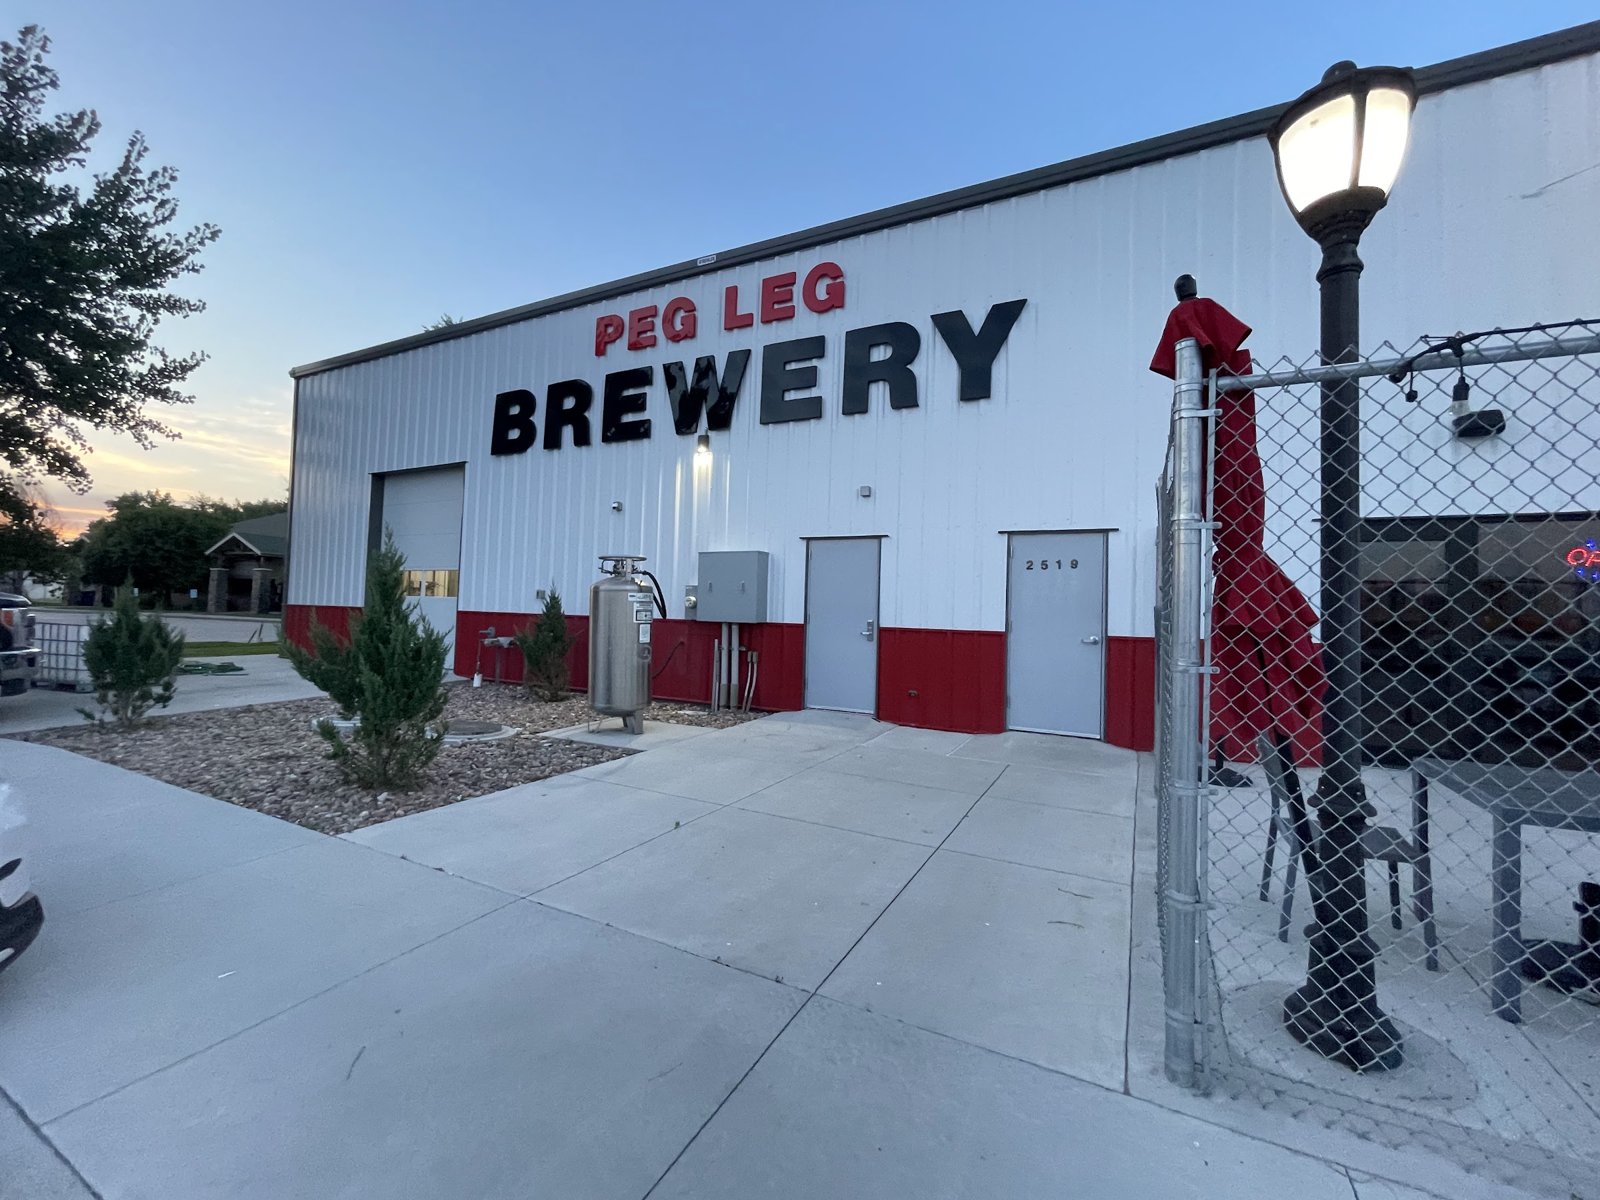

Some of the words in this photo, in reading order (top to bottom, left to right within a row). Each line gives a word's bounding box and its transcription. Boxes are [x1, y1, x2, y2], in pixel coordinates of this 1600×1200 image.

[594, 296, 697, 357] PEG
[723, 262, 846, 331] LEG
[490, 298, 1028, 456] BREWERY
[1025, 559, 1079, 571] 2519
